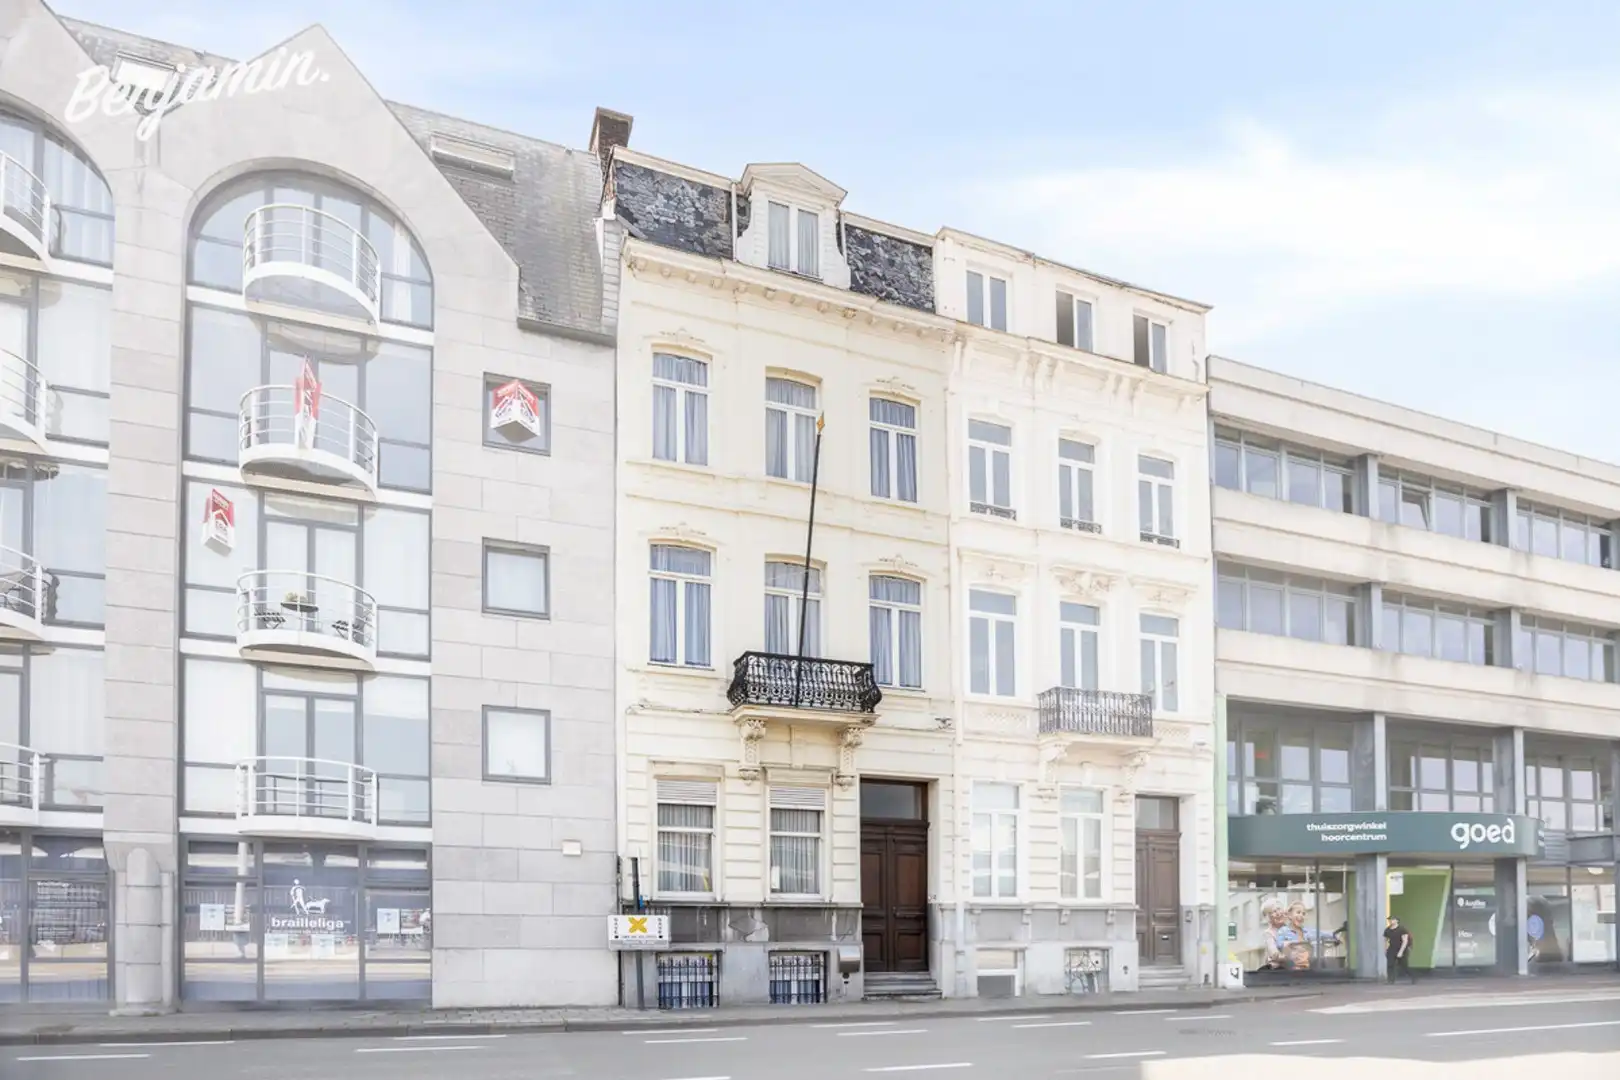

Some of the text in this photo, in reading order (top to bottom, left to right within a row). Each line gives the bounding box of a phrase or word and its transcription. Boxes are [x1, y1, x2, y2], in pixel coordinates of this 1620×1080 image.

[1306, 822, 1387, 833] thuiszorgwinkel
[1450, 818, 1516, 849] goed
[1321, 833, 1387, 842] hoorcentrum
[272, 917, 344, 930] brailleliga
